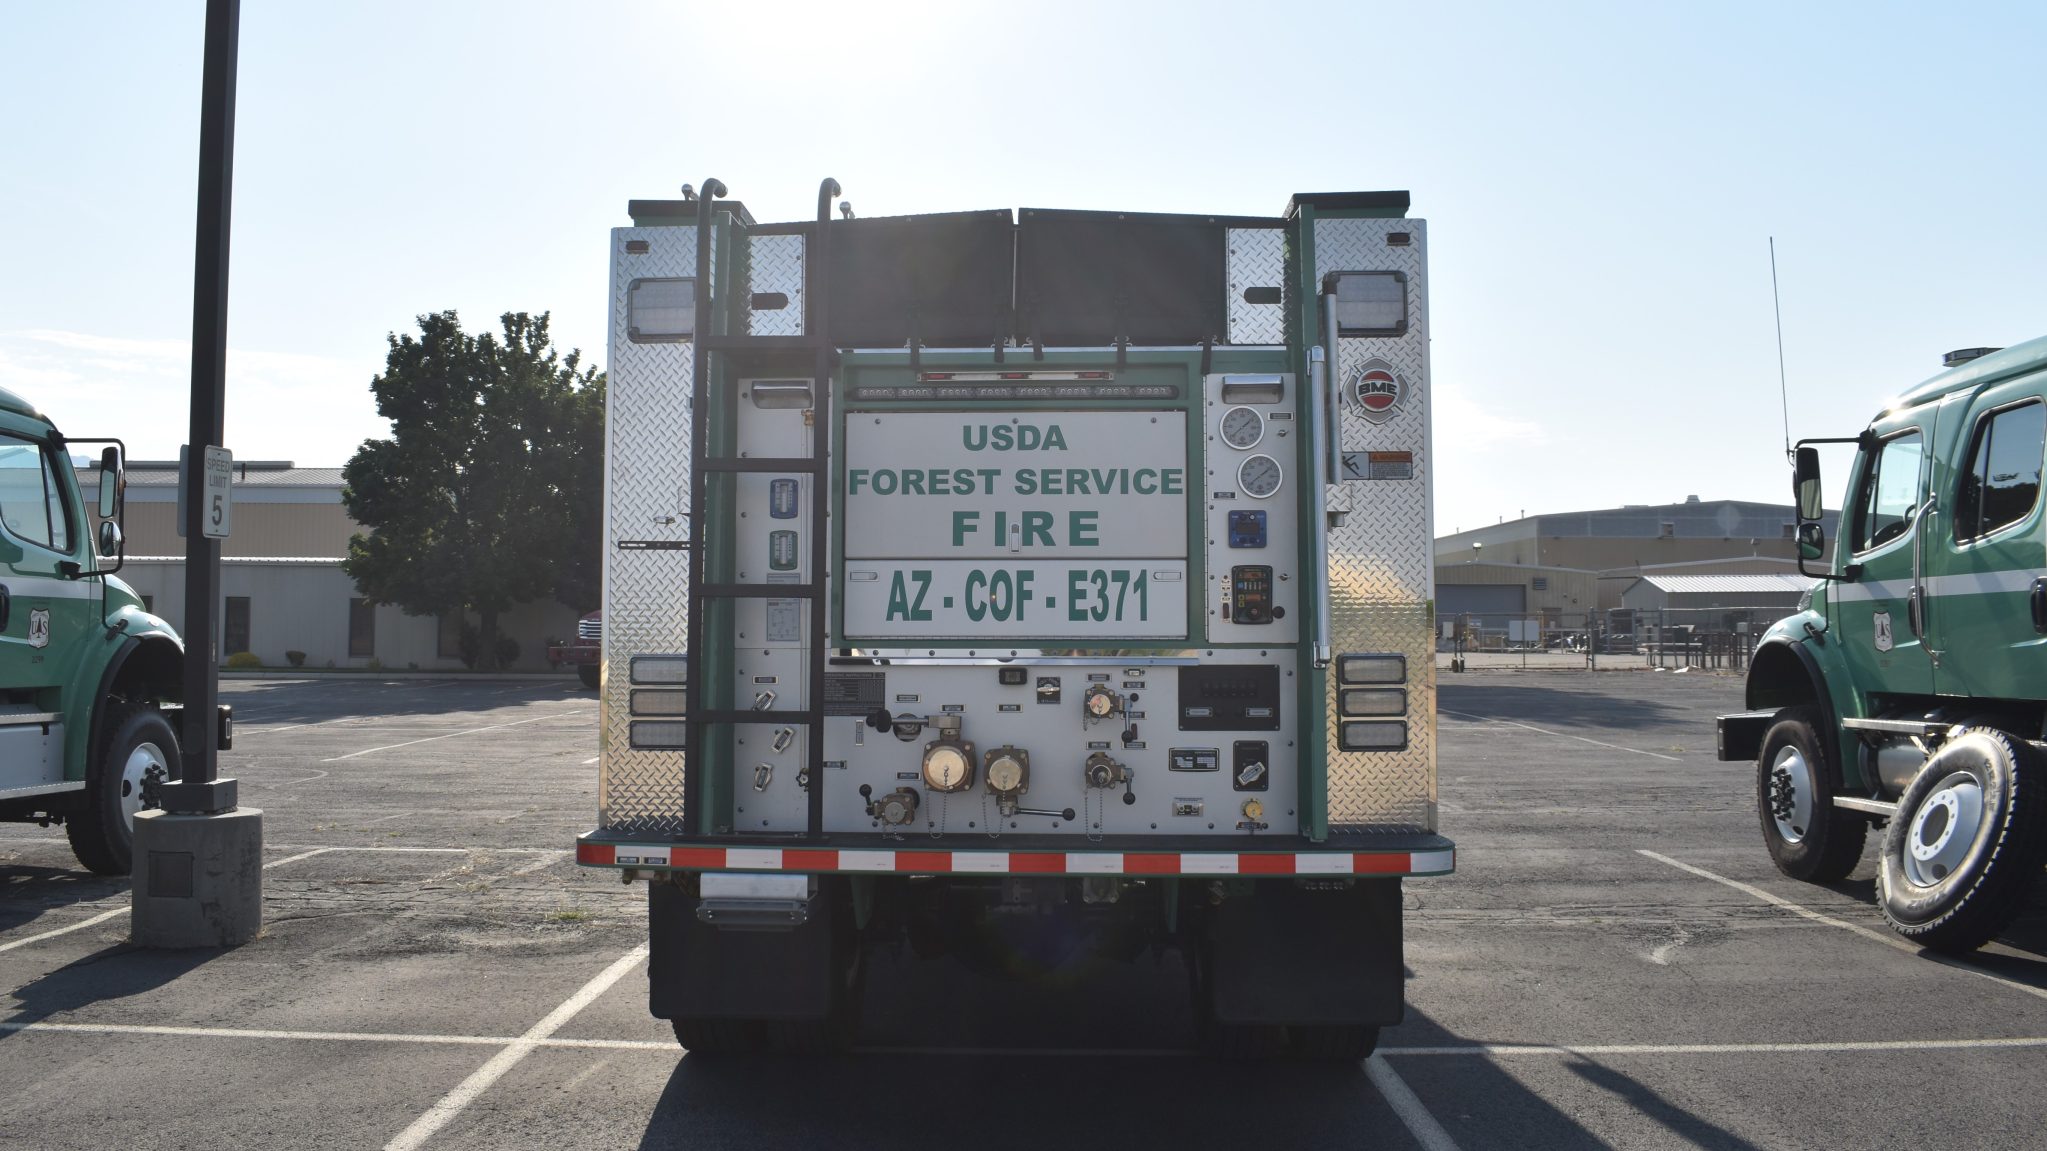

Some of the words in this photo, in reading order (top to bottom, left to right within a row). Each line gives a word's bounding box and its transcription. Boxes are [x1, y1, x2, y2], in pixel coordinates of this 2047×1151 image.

[1358, 382, 1397, 396] BME
[963, 424, 1068, 452] USDA
[207, 457, 230, 473] SPEED
[209, 474, 228, 489] LIMIT
[849, 468, 1001, 496] FOREST
[1014, 468, 1184, 496] SERVICE
[211, 494, 223, 526] 5
[952, 510, 1100, 547] FIRE
[1068, 568, 1148, 622] E371
